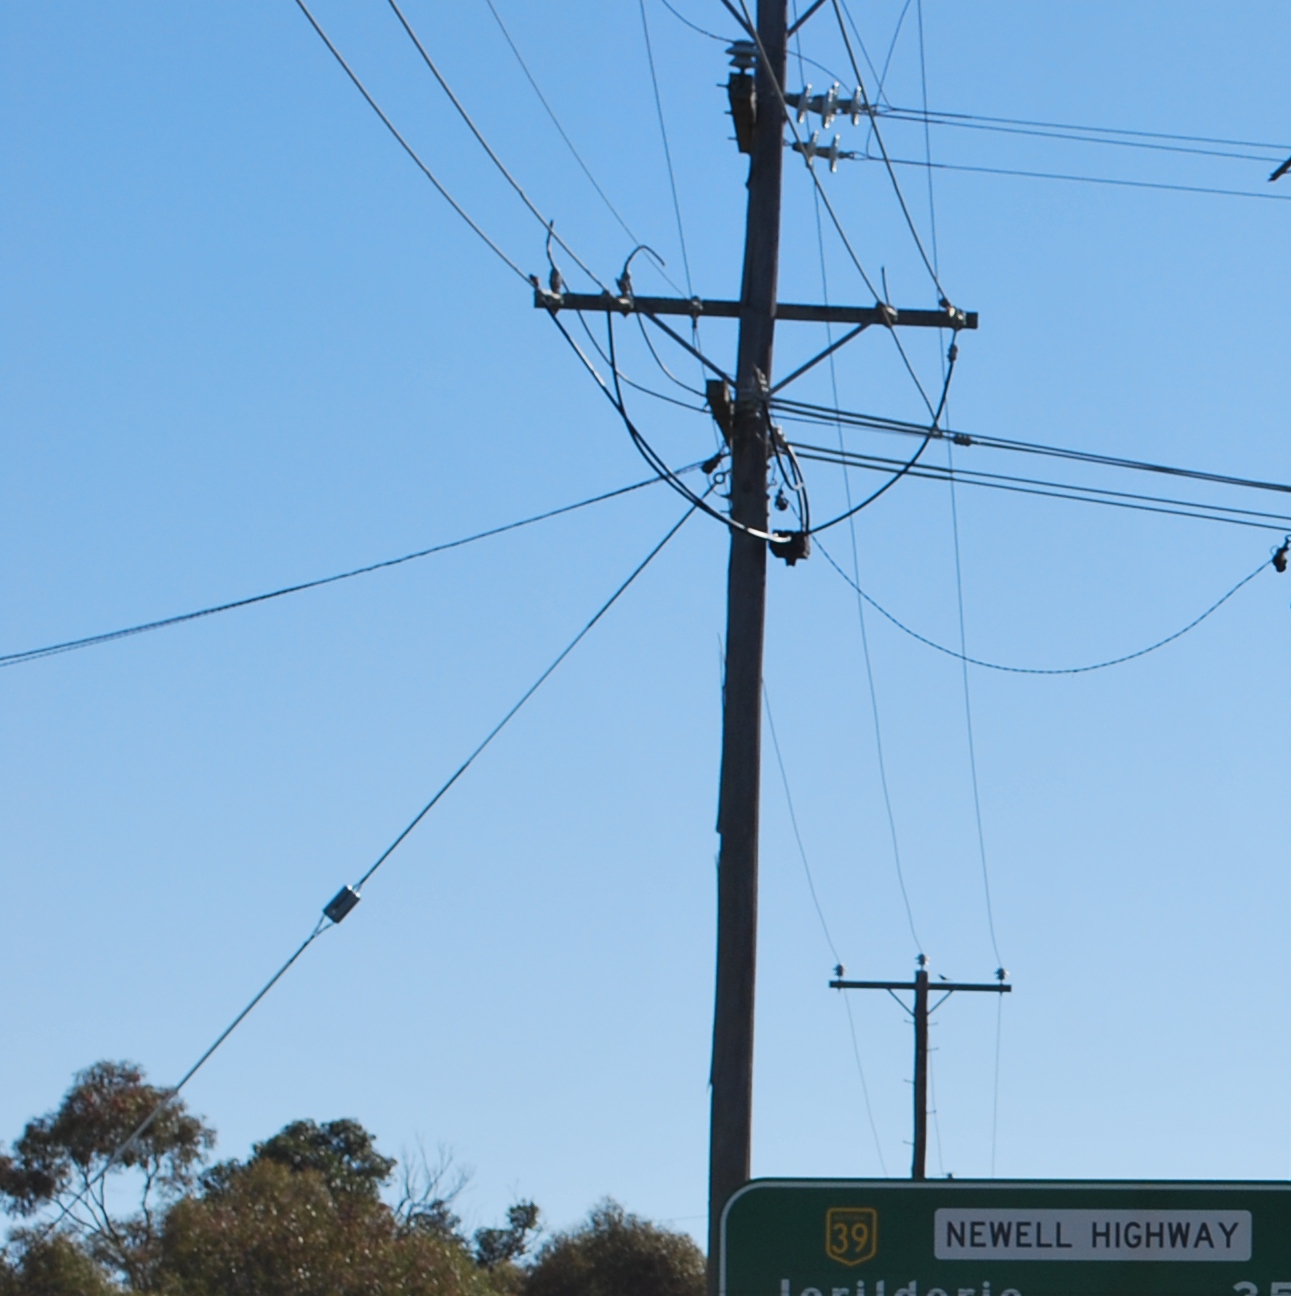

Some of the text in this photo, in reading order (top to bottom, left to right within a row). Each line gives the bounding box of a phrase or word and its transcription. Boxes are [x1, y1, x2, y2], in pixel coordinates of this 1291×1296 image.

[831, 1222, 868, 1254] 39
[946, 1221, 1239, 1249] NEWELL HIGHWAY
